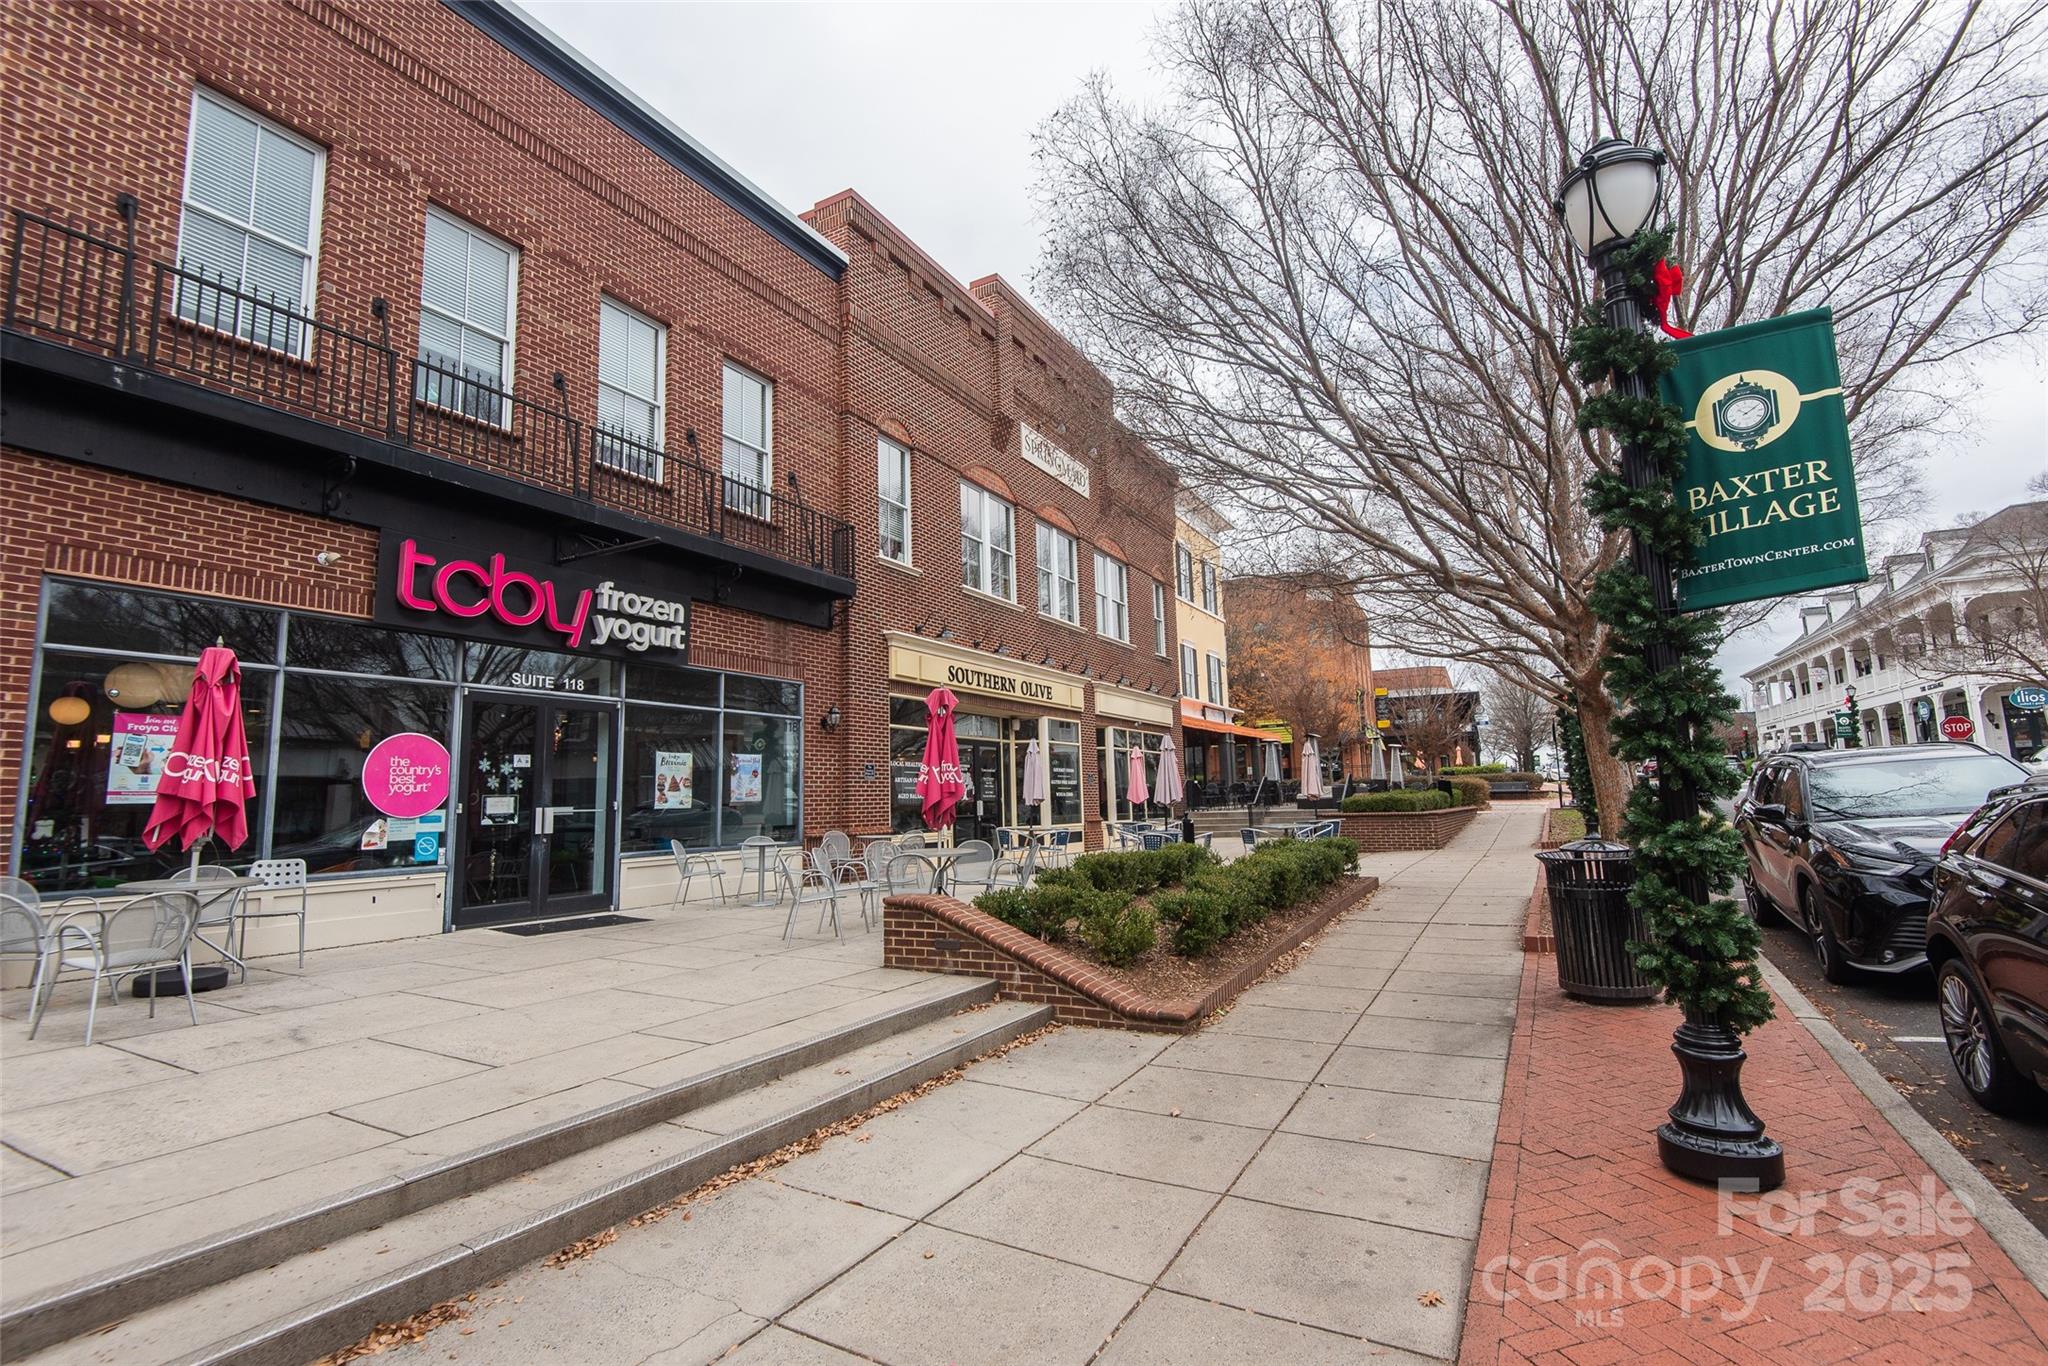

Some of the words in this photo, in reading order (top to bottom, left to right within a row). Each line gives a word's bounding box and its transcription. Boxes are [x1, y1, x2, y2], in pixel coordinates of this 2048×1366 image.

[1687, 460, 1832, 513] BAXTER
[1702, 487, 1841, 537] ILLAGE
[396, 538, 593, 648] tcby
[595, 581, 685, 624] frozen
[591, 615, 686, 651] yogurt
[511, 672, 555, 689] SUITE
[562, 678, 585, 691] 118
[948, 665, 1016, 693] SOUTHERN
[1021, 680, 1053, 700] OLIVE
[2017, 690, 2046, 703] ilios
[127, 723, 160, 733] Froyo
[161, 725, 179, 733] Clu
[1944, 723, 1971, 732] STOP
[390, 756, 410, 767] the
[389, 765, 441, 778] country's
[389, 774, 416, 785] best
